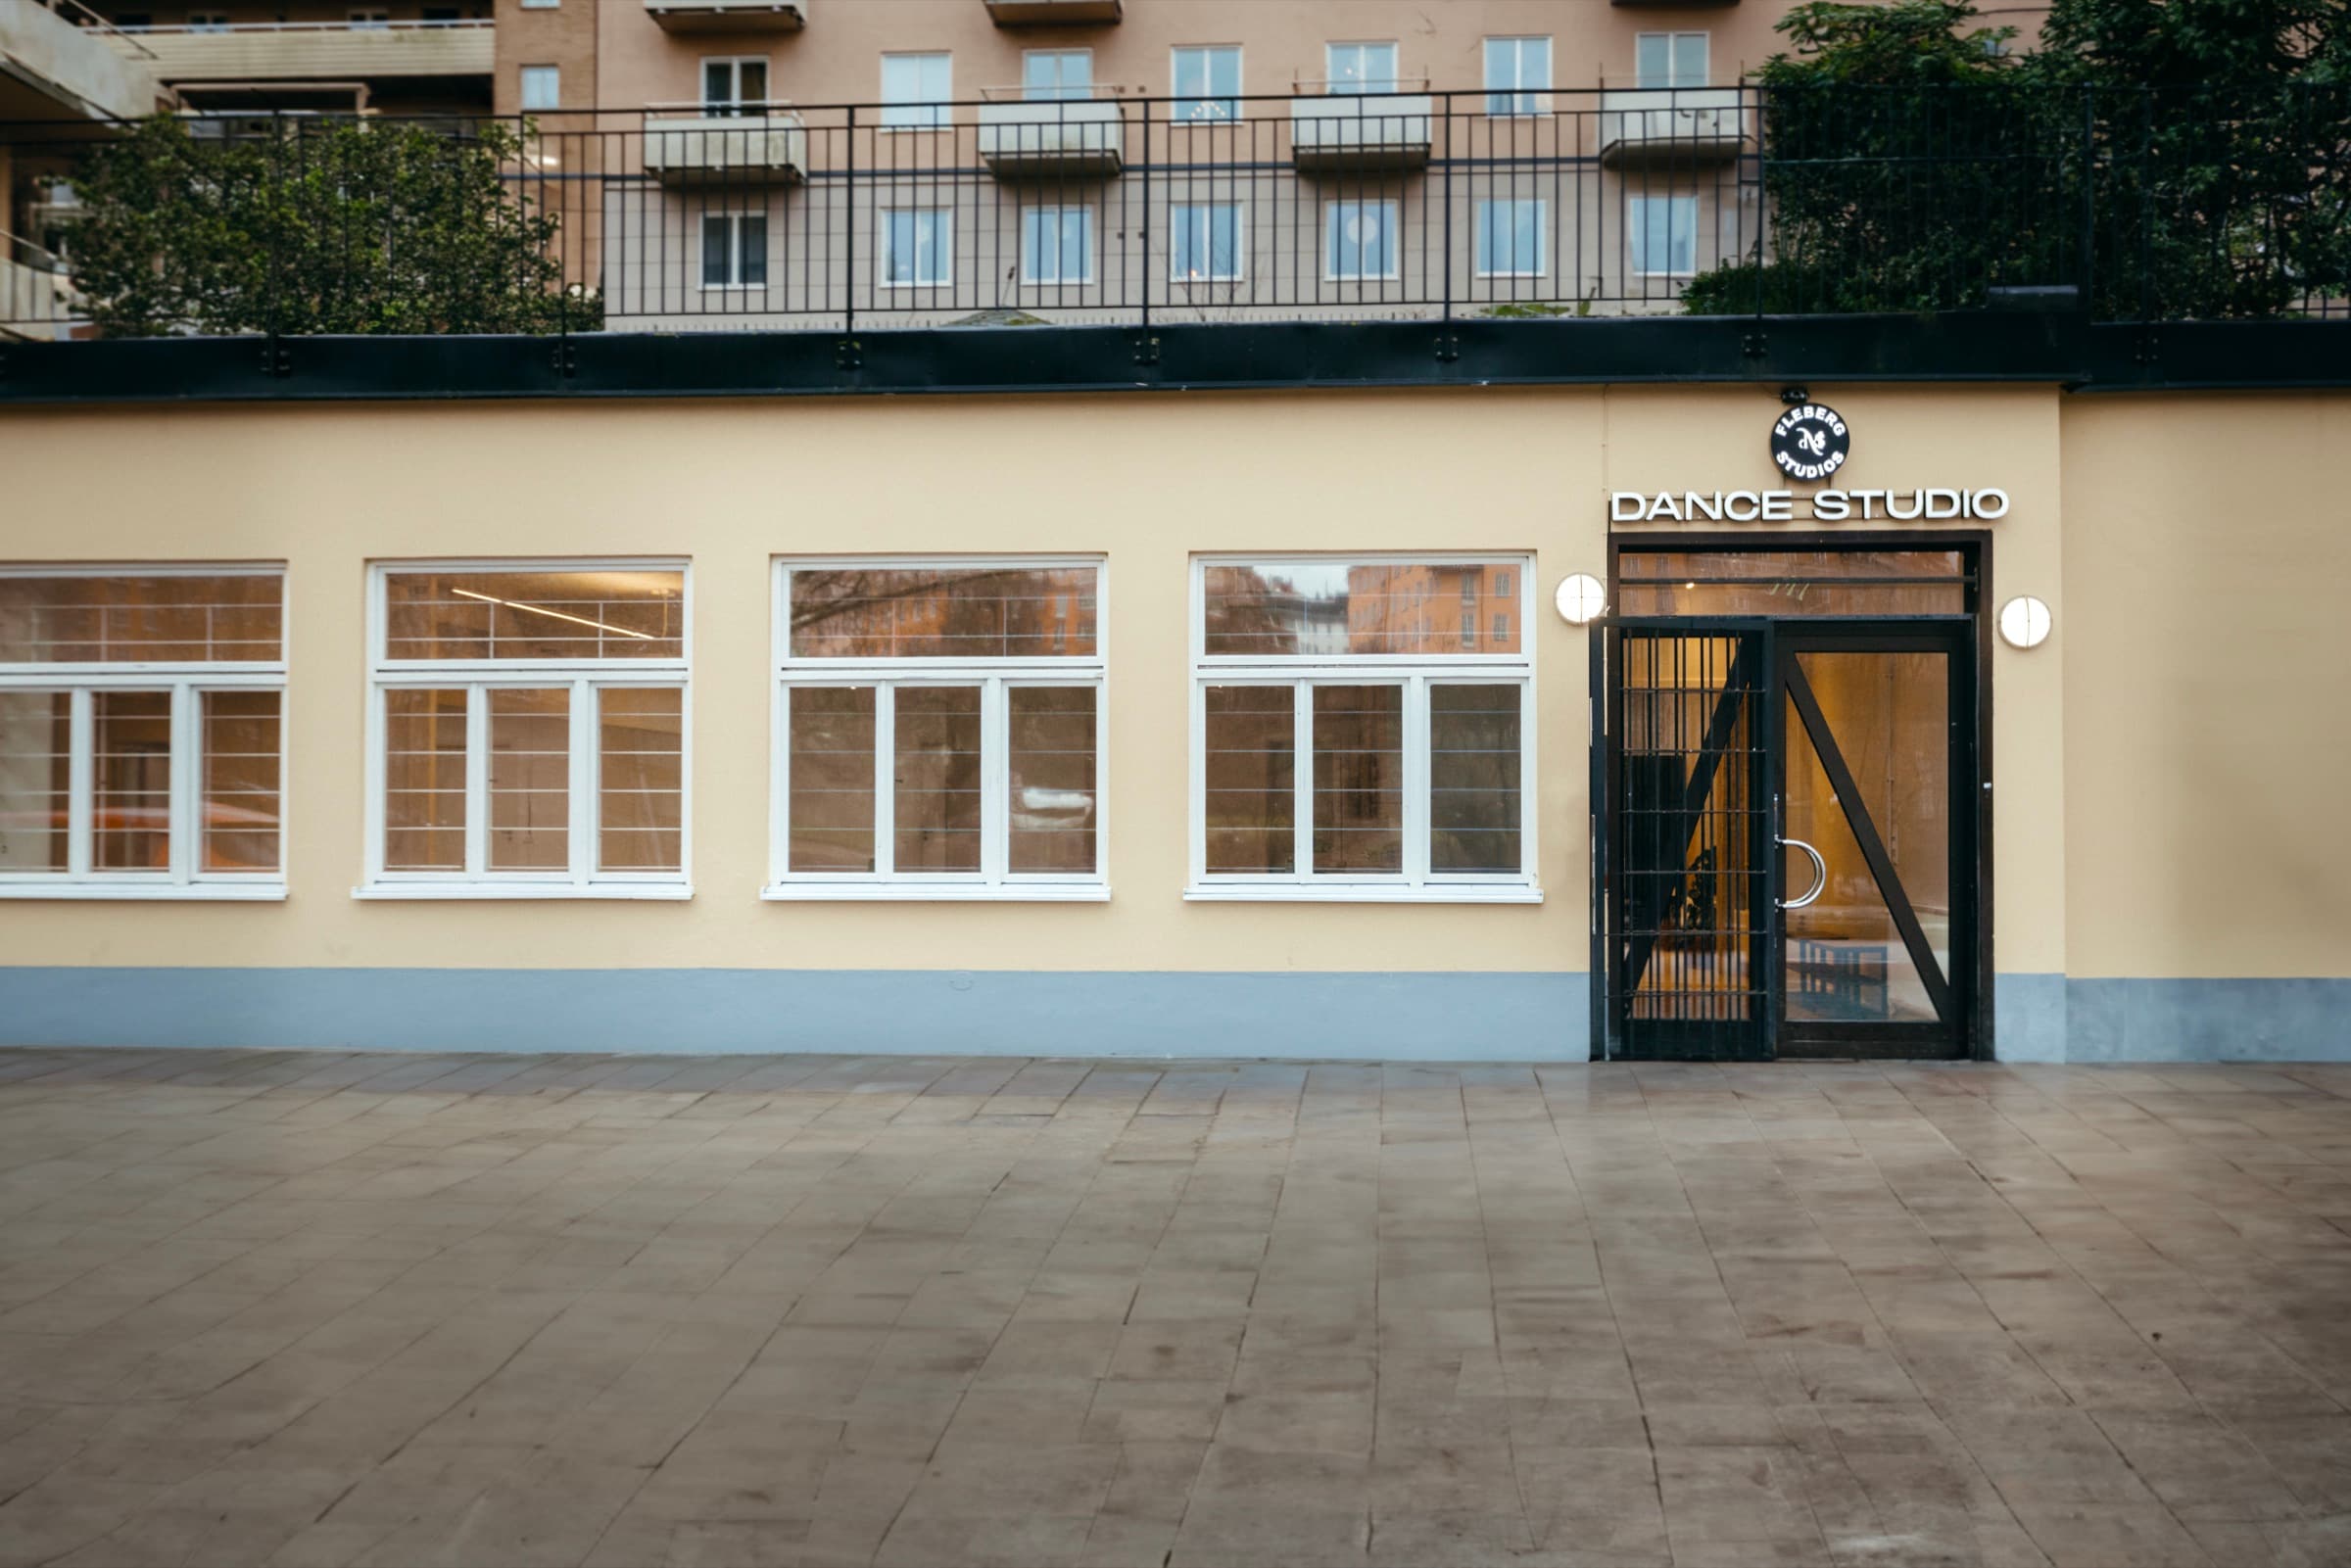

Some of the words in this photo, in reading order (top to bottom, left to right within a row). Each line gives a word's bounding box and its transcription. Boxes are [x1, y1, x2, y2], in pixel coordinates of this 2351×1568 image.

[1775, 405, 1846, 437] FLEBERG
[1776, 451, 1845, 478] STUDIOS
[1611, 491, 1793, 521] DANCE
[1813, 489, 2010, 520] STUDIO
